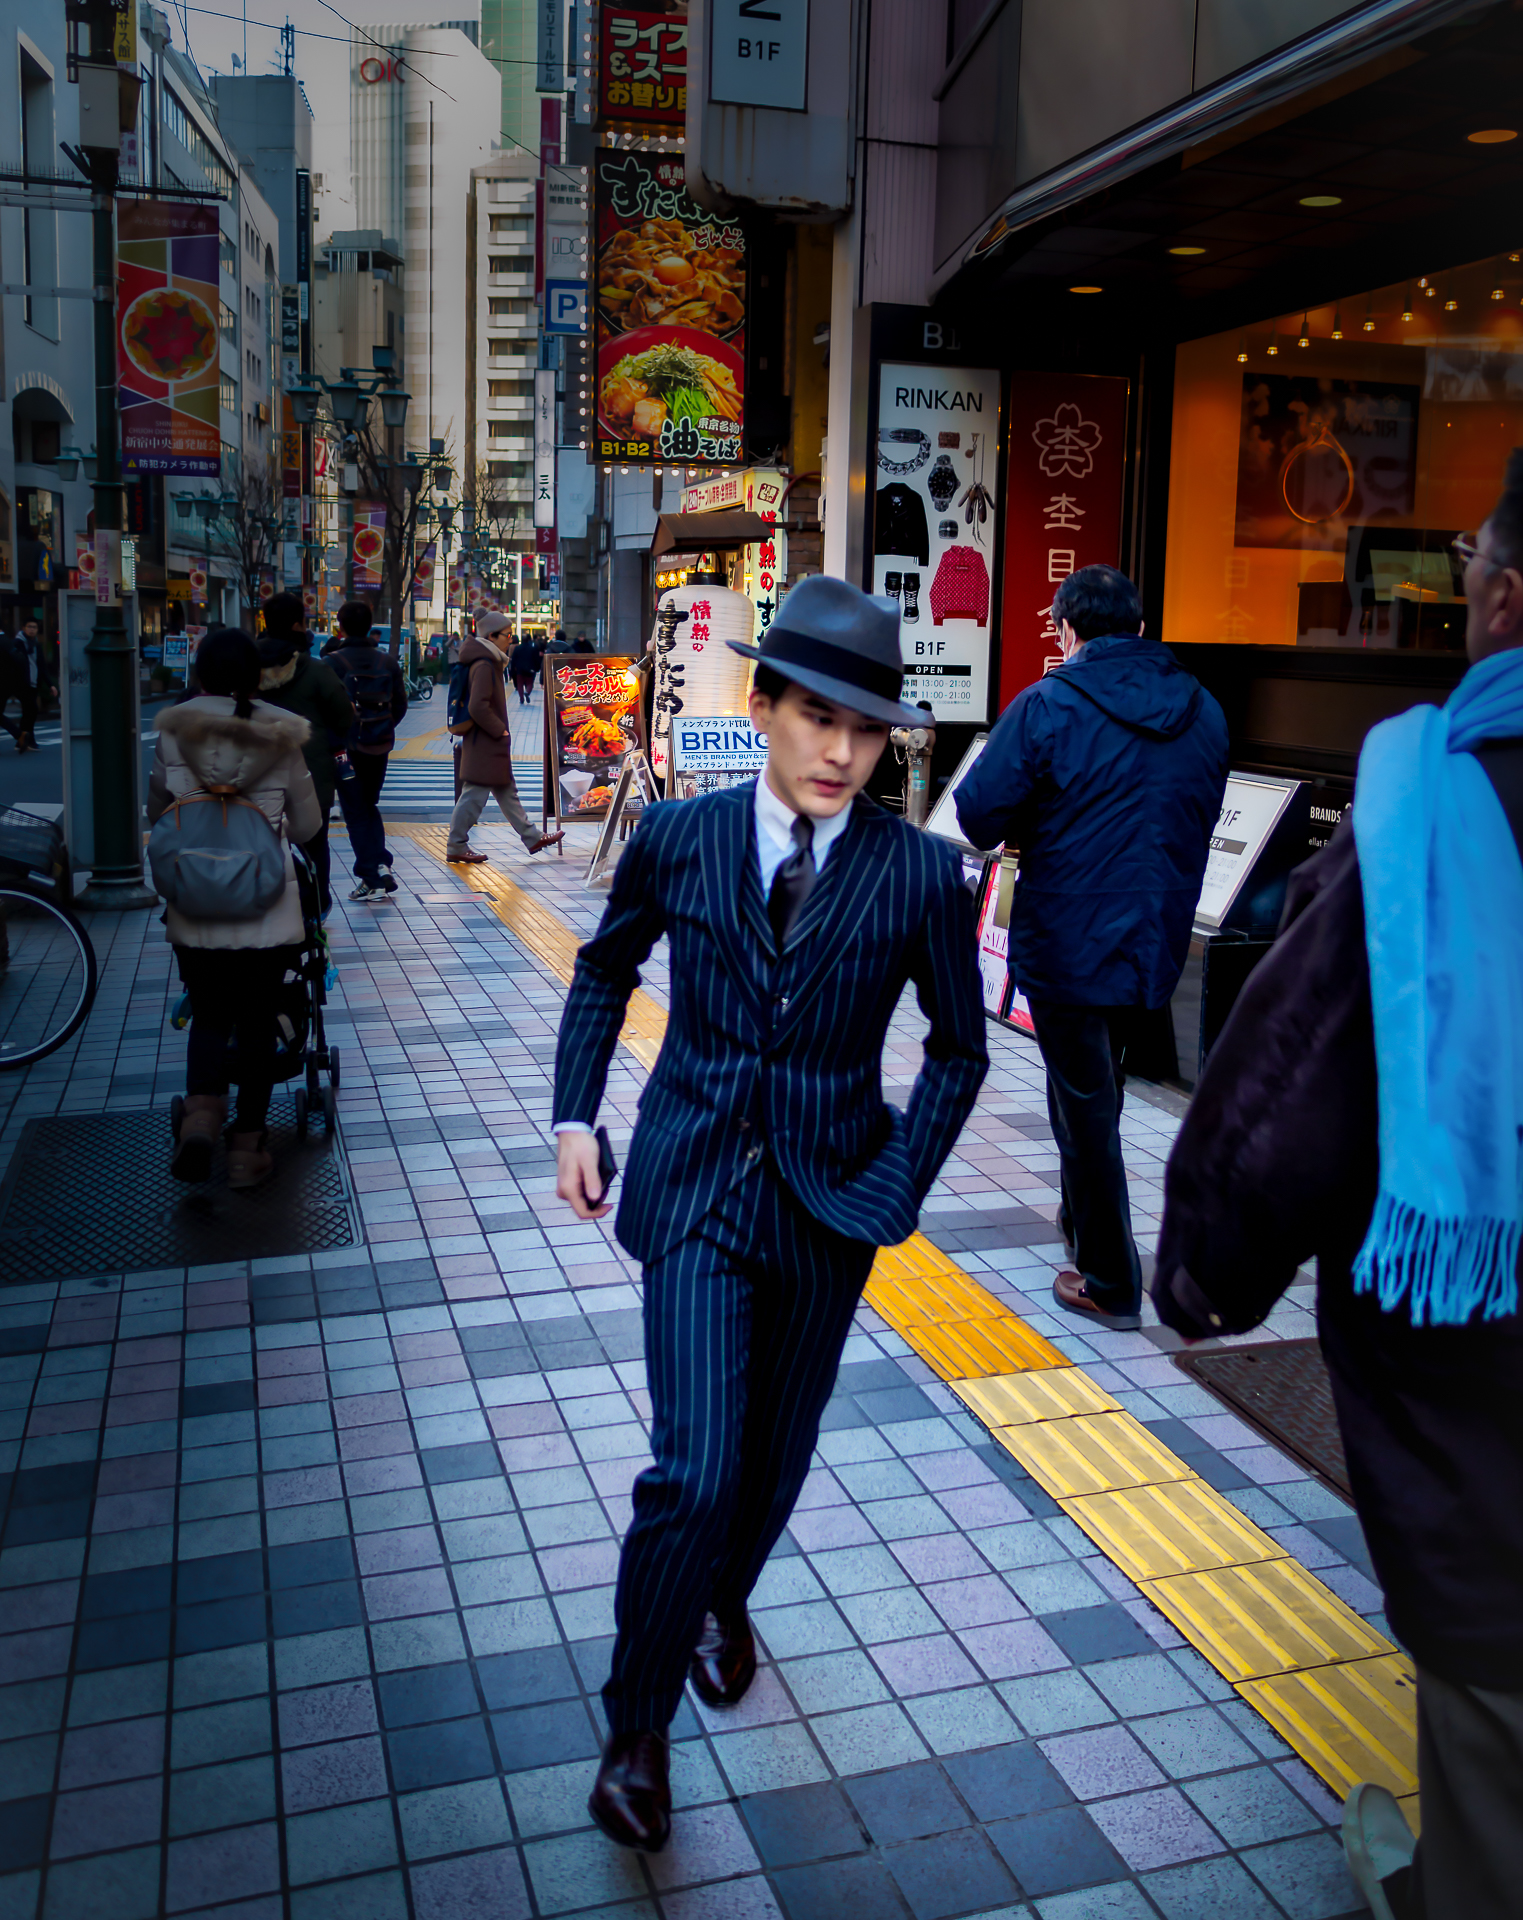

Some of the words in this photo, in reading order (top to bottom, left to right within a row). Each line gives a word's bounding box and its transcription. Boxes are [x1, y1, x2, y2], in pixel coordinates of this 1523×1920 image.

[738, 38, 780, 60] B1F
[895, 386, 983, 413] RINKAN
[178, 429, 215, 437] HATTENKAI
[698, 417, 740, 434] 東京名物
[125, 436, 218, 452] 新宿中央通発展会
[660, 415, 742, 459] 油そば
[139, 458, 217, 471] 防犯カメラ作動中
[538, 475, 550, 500] 三太
[690, 600, 711, 652] 情熱の
[915, 641, 946, 656] B1F
[556, 663, 605, 684] チーズ
[915, 666, 943, 674] OPEN
[1310, 806, 1342, 824] BRANDS
